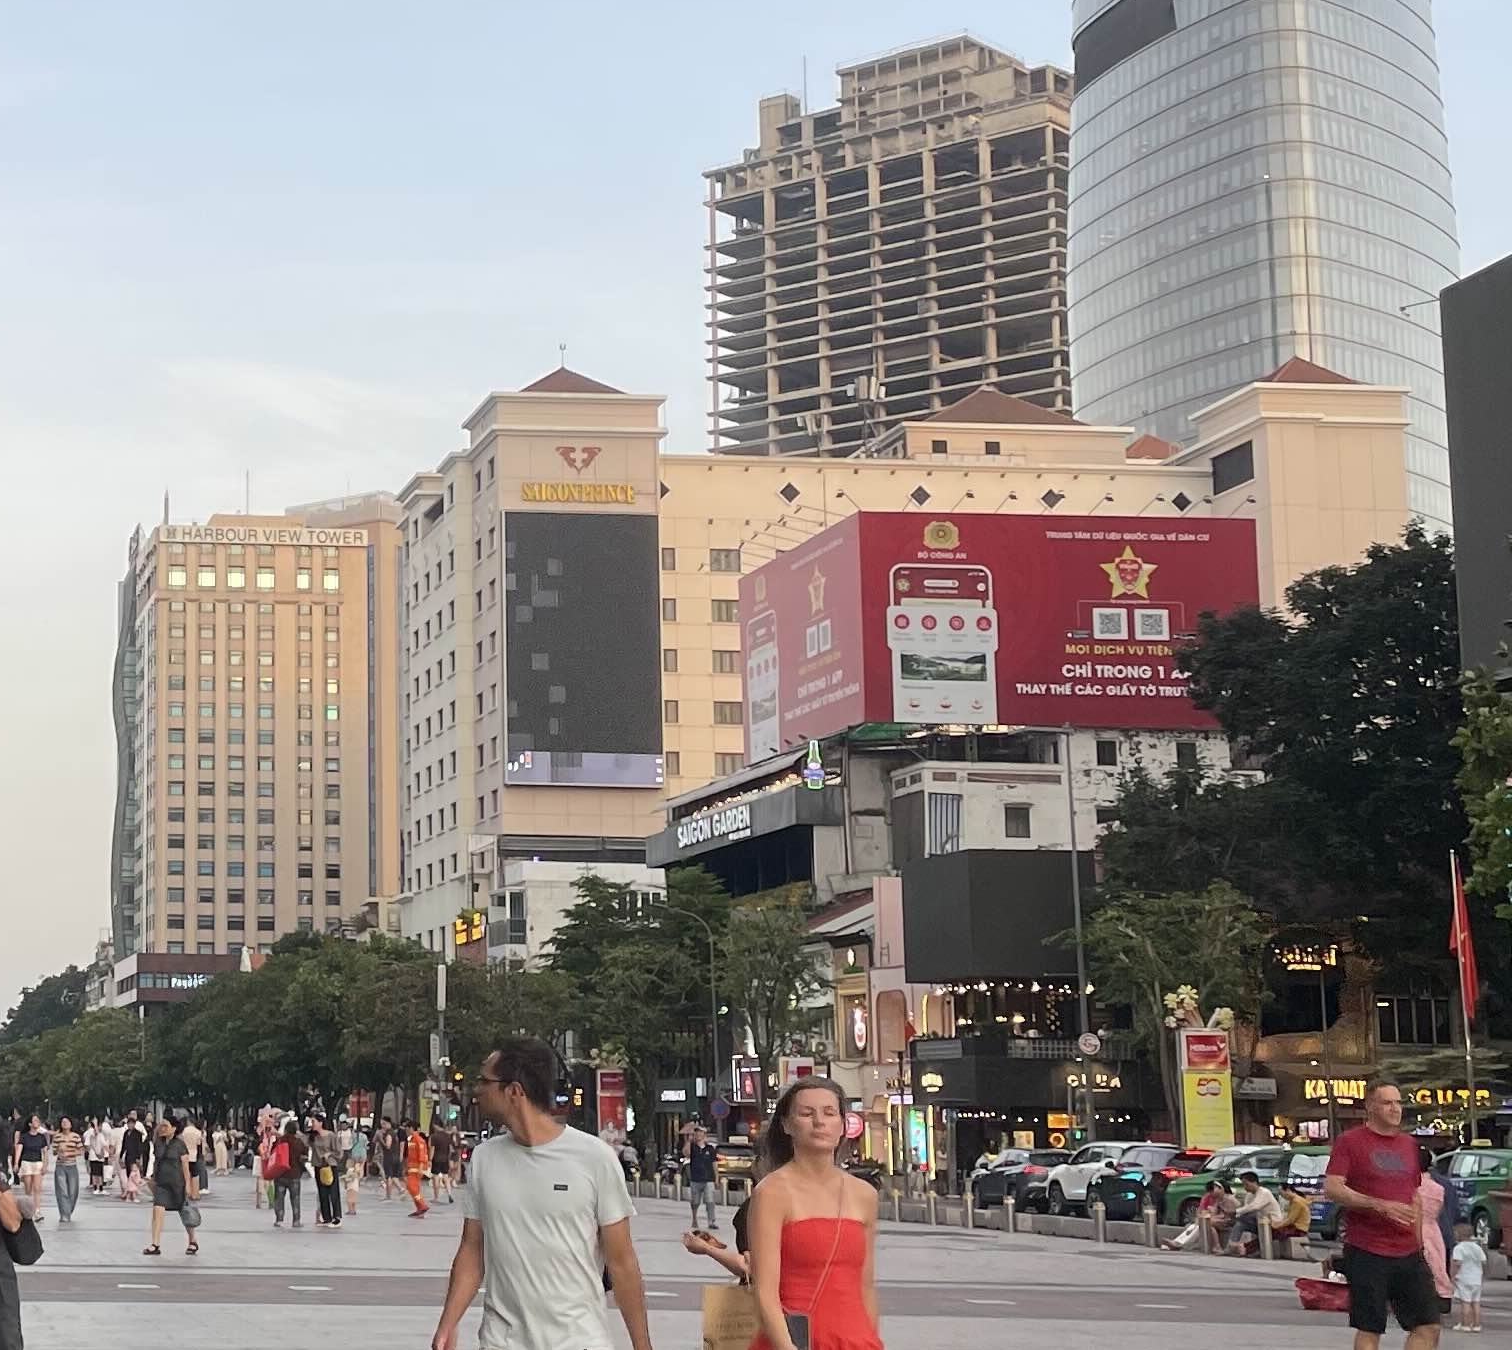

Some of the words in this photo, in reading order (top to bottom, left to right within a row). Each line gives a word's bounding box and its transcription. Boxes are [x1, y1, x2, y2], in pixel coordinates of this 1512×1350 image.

[522, 482, 579, 502] SAIGON
[581, 484, 636, 504] PRINCE
[182, 528, 258, 543] HARBOUR
[262, 529, 303, 543] VIEW
[307, 530, 364, 545] TOWER
[1094, 644, 1125, 656] DỊCH
[1062, 661, 1092, 679] CHỈ
[1095, 664, 1153, 679] TRONG
[1156, 665, 1166, 679] 1
[1016, 683, 1048, 695] THAY
[1049, 681, 1073, 695] THẾ
[1075, 683, 1104, 696] CÁC
[1106, 683, 1137, 697] GIẤY
[1140, 684, 1157, 696] TỜ
[677, 817, 712, 849] SAIGON
[712, 803, 751, 837] GARDEN
